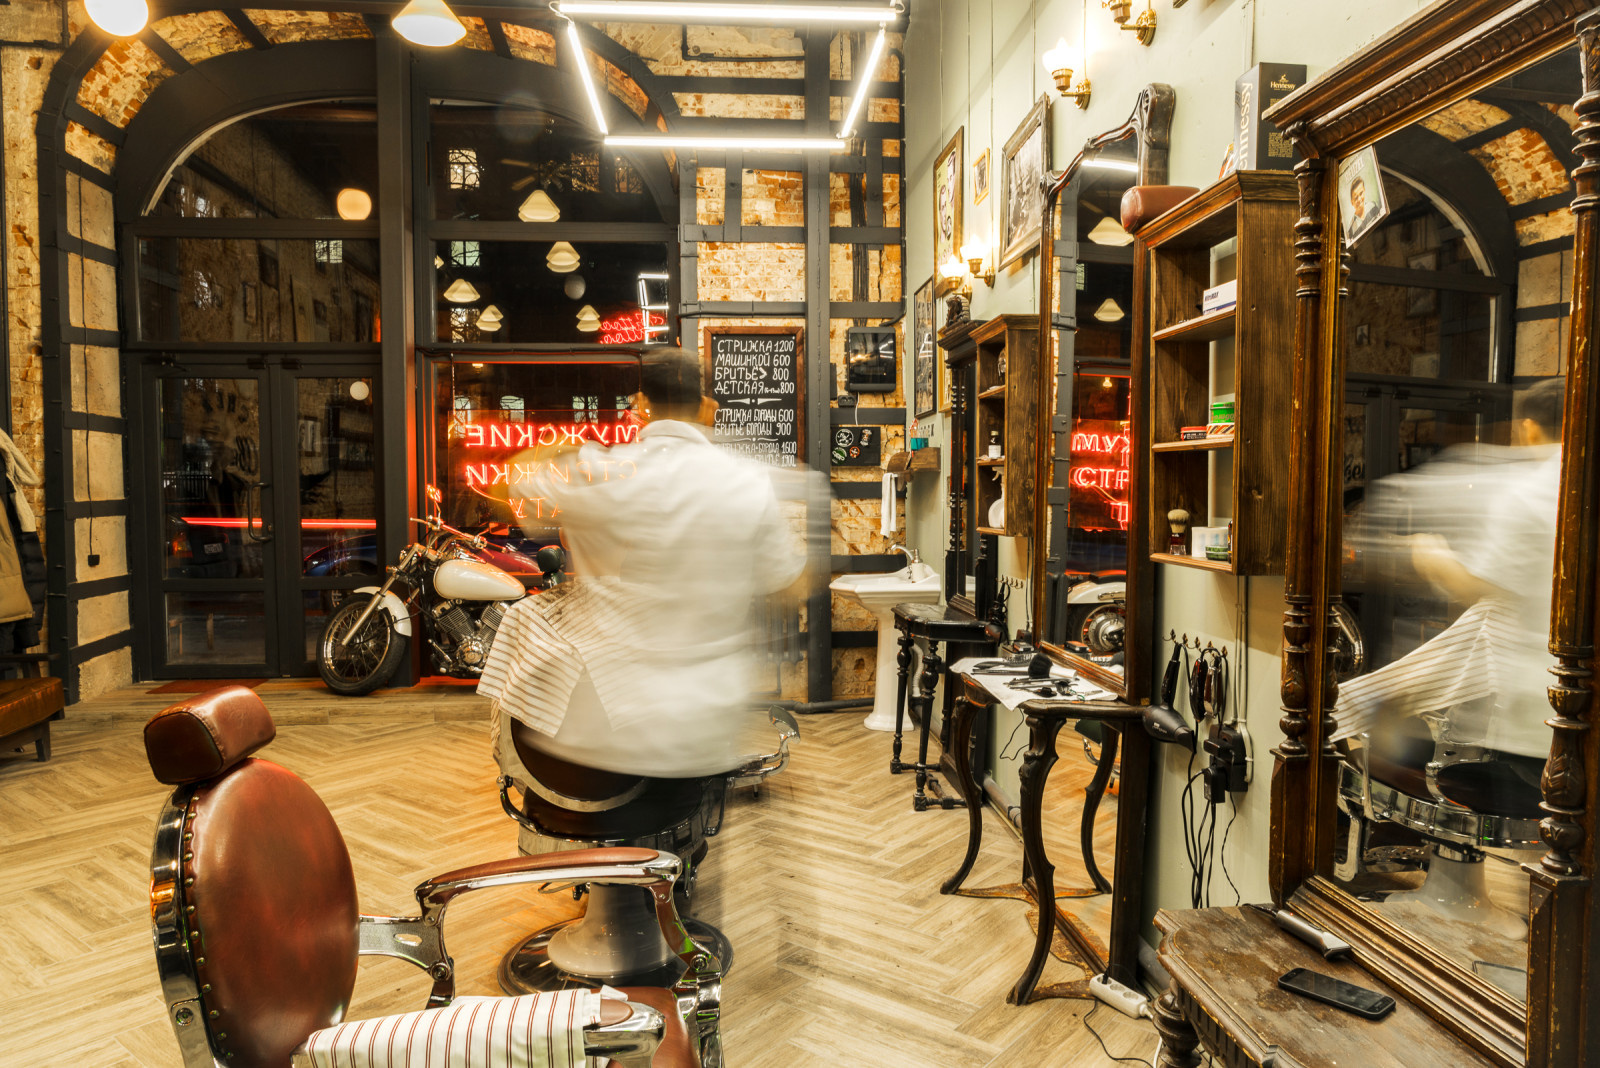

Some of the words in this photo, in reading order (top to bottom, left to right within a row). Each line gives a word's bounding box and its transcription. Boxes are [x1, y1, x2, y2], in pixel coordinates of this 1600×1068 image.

[1270, 81, 1297, 90] Hennessy
[1239, 82, 1253, 170] ennessy
[717, 340, 773, 353] СТРИЖКА
[774, 340, 794, 353] 1200
[715, 353, 770, 367] МАШИНКОЙ
[773, 355, 790, 367] 600
[715, 366, 759, 380] БРИТЬЁ
[772, 368, 789, 380] 800
[714, 381, 765, 394] ДЕТСКАЯ
[780, 382, 794, 394] 800
[714, 409, 752, 422] СТРИЖКА
[754, 409, 777, 422] БОРОДЫ
[778, 409, 794, 422] 600
[715, 422, 745, 435] БРИТЬЁ
[746, 423, 772, 435] БОРОДЫ
[775, 423, 791, 435] 900
[781, 441, 797, 454] 1600
